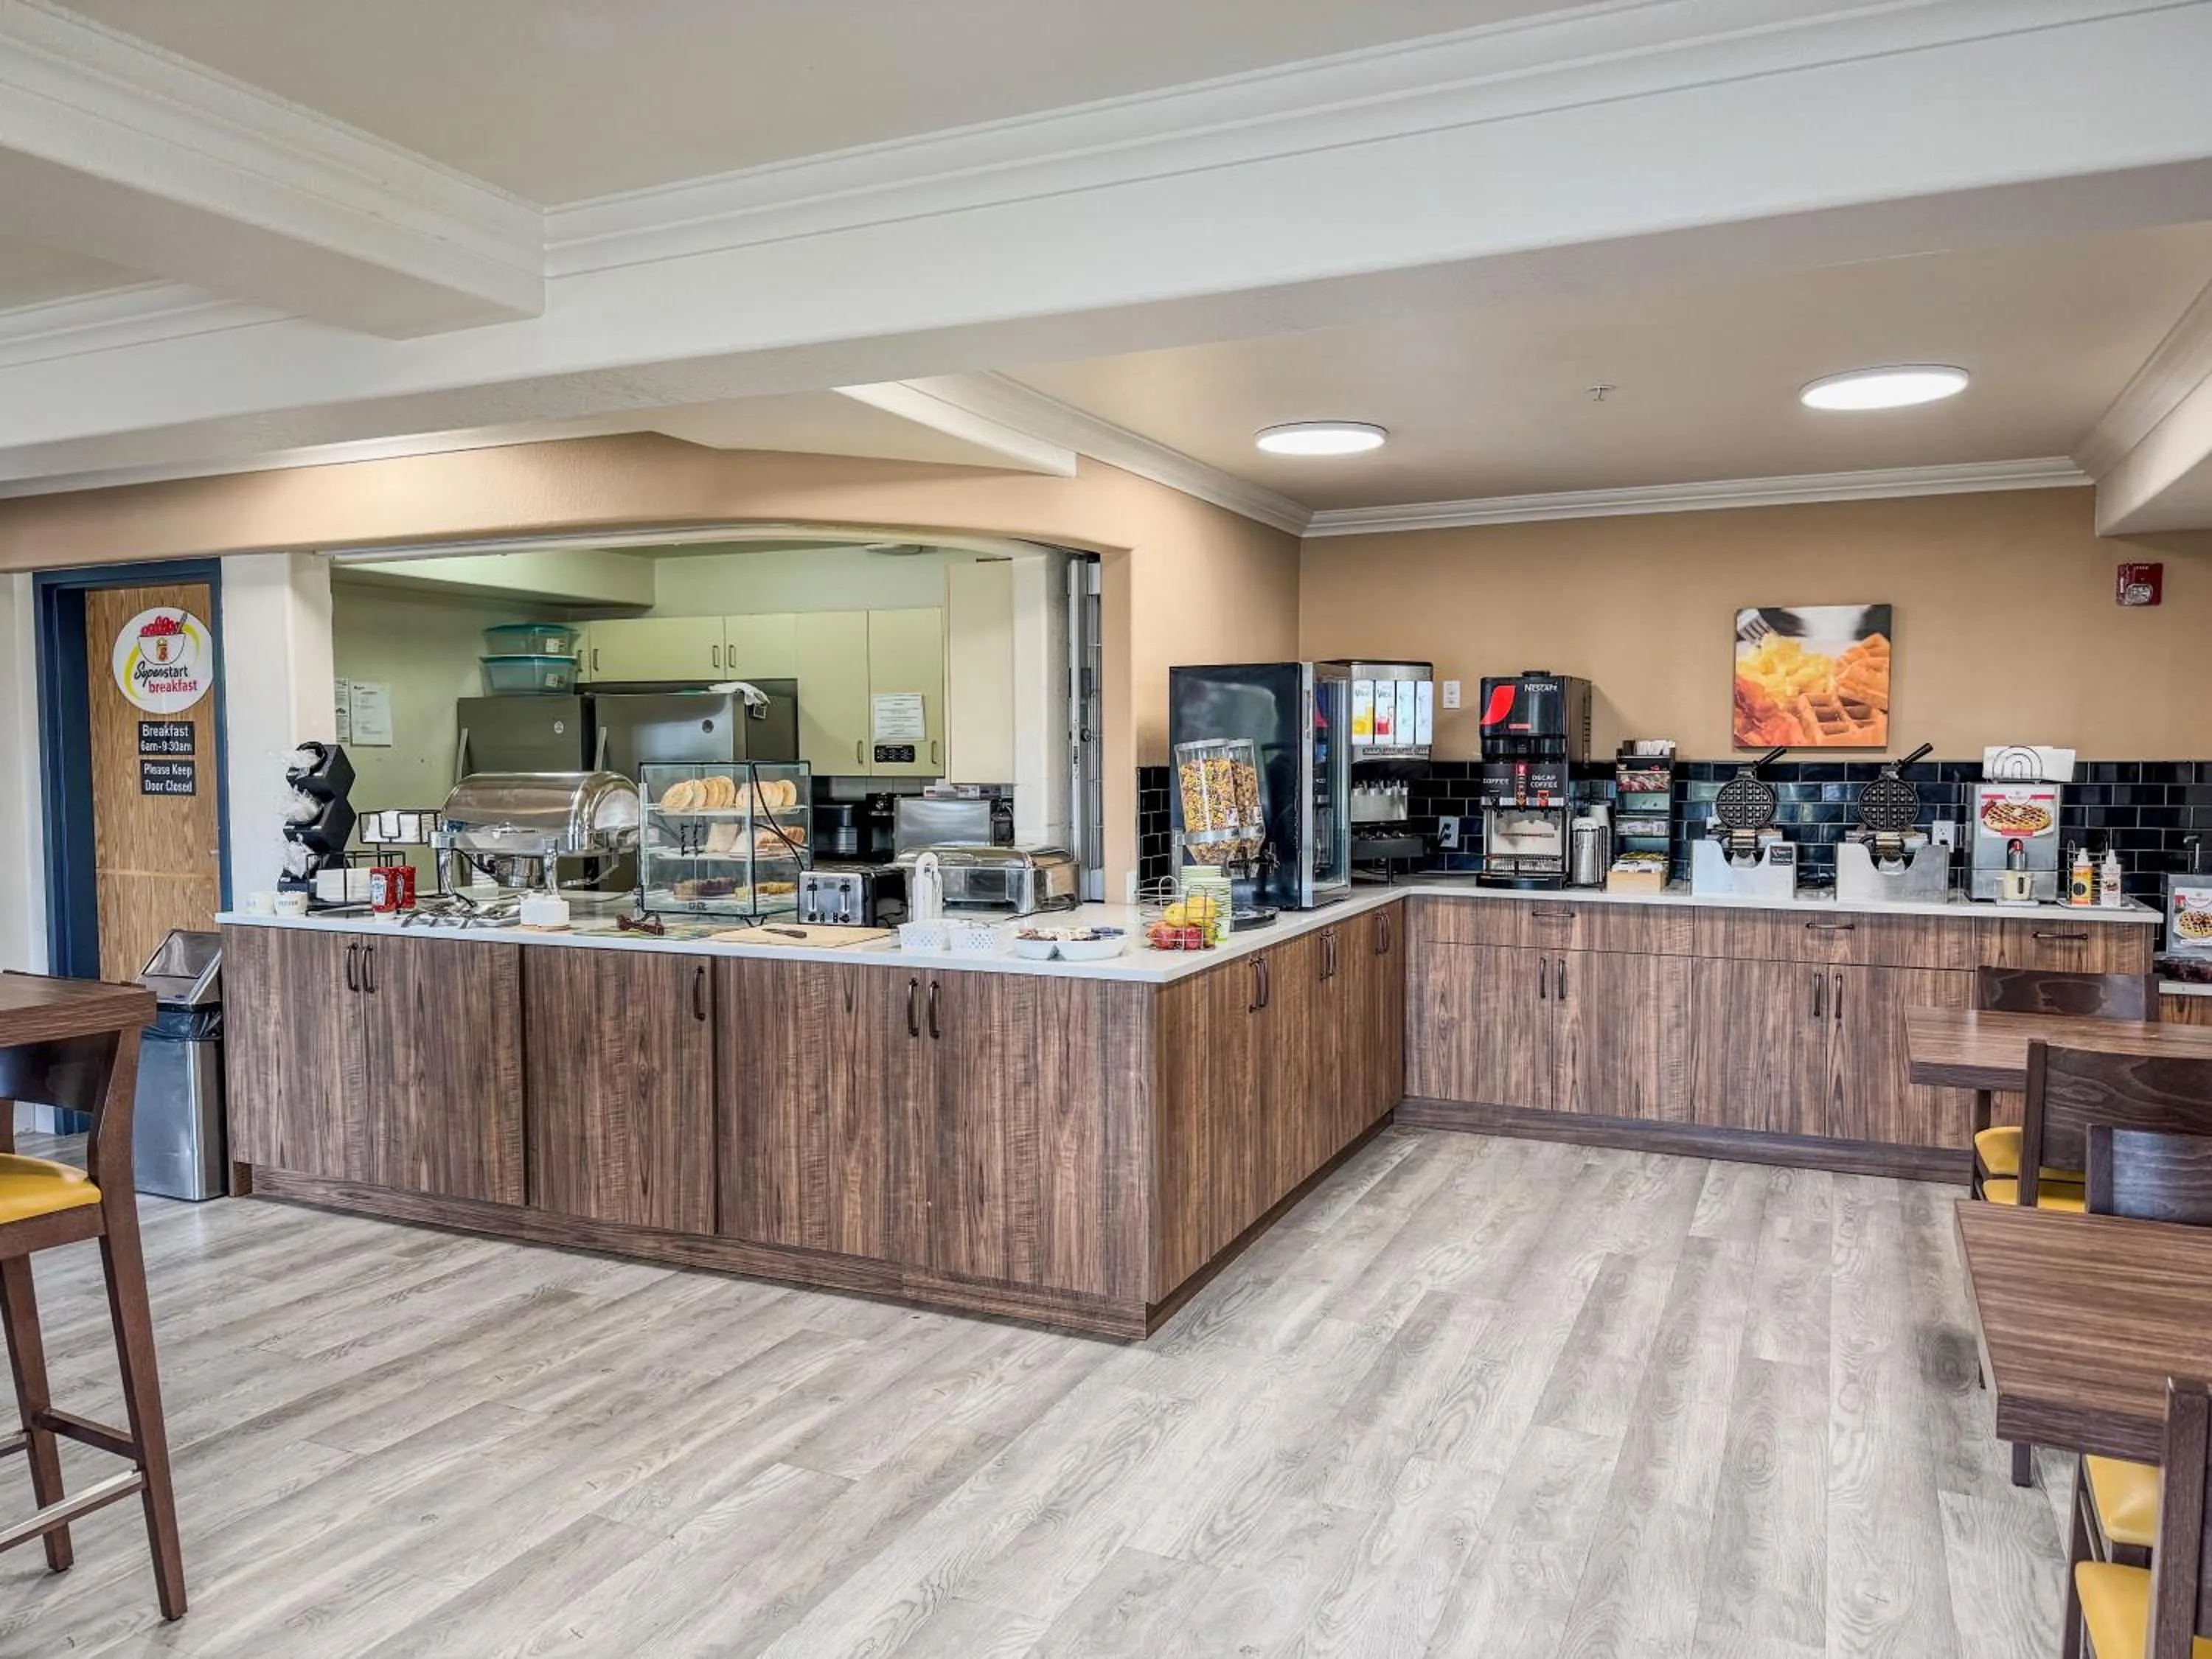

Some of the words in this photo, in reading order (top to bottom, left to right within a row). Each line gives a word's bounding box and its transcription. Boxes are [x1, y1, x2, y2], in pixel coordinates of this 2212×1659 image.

[133, 661, 188, 687] Superstart
[148, 679, 198, 693] breakfast
[142, 724, 189, 737] Breakfast
[144, 762, 170, 775] Please
[172, 763, 192, 778] Keep
[145, 779, 164, 791] Door
[166, 780, 192, 793] Closed
